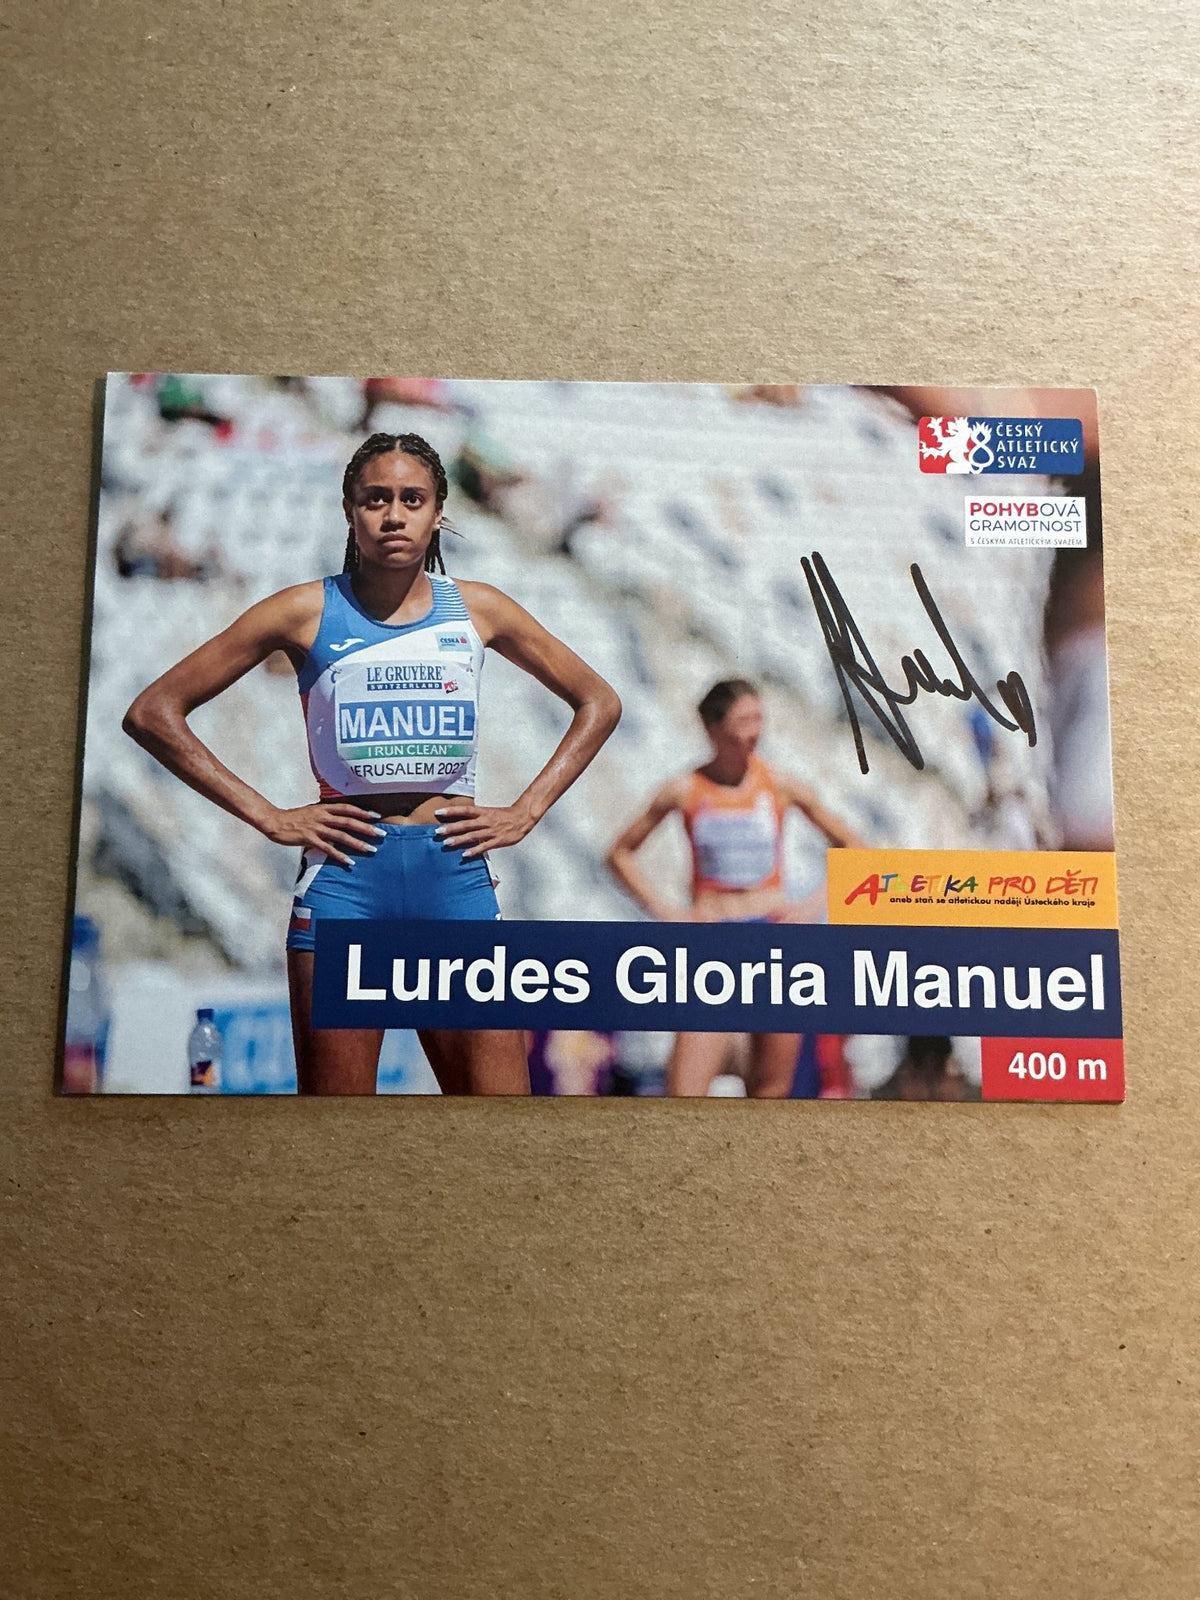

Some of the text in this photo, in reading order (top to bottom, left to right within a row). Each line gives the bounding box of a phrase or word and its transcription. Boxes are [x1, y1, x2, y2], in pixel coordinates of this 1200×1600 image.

[996, 422, 1043, 437] ČESKÝ
[996, 439, 1079, 454] ATLETICKÝ
[998, 456, 1037, 469] SVAZ
[970, 500, 1081, 517] POHYBOVÁ
[969, 519, 1082, 533] GRAMOTNOST
[970, 537, 975, 545] S
[1053, 538, 1082, 546] SVAZEM
[367, 667, 382, 682] LE
[340, 705, 474, 740] MANUEL
[367, 747, 372, 757] I
[375, 745, 403, 756] RUN
[988, 875, 1036, 895] PRO
[1046, 869, 1099, 895] DĚTI
[948, 896, 991, 904] atletickou
[1072, 898, 1096, 908] kraje
[347, 944, 1107, 1011] Lurdes Gloria Manuel
[1008, 1053, 1108, 1081] 400 m
